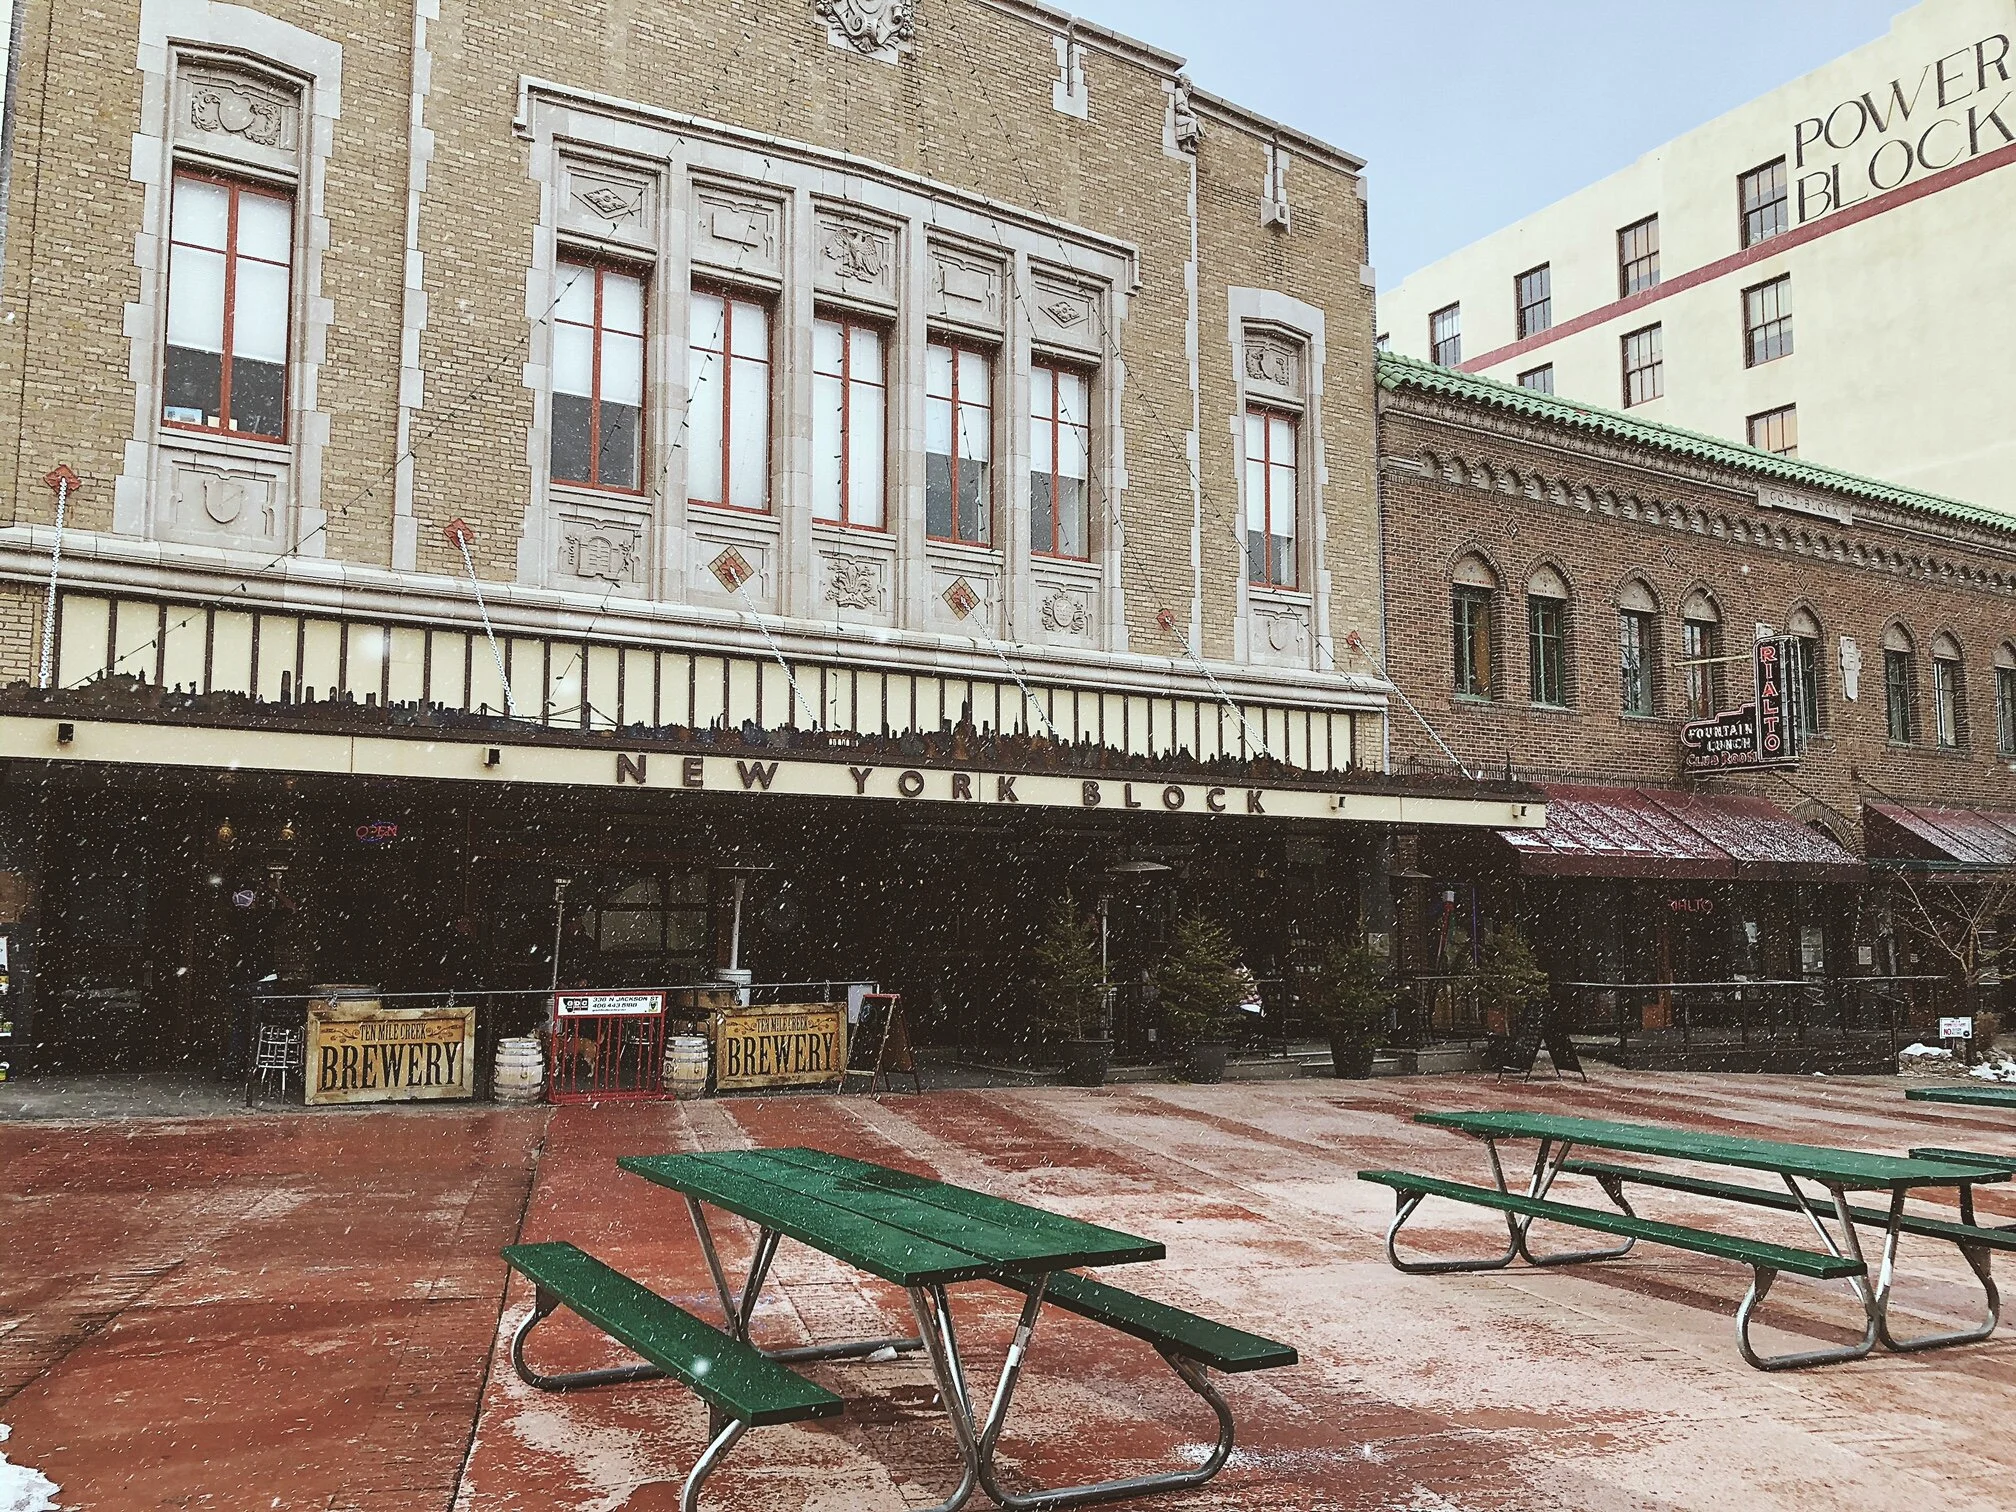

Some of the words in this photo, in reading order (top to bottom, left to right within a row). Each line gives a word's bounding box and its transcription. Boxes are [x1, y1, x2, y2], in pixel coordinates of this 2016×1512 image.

[1794, 33, 2012, 170] POWER
[1797, 90, 2016, 224] BLOCK
[1760, 646, 1780, 751] RIALTO
[1688, 723, 1753, 739] FOUNTAIN
[1707, 737, 1751, 752] LUNCH
[617, 753, 779, 790] NEW
[850, 765, 1019, 803] YORK
[1082, 779, 1266, 815] BLOCK
[359, 1022, 376, 1041] TEN
[378, 1022, 399, 1041] MILE
[401, 1021, 427, 1040] CREEK
[726, 1032, 835, 1077] BREWERY
[1944, 1028, 1952, 1036] NO
[320, 1042, 462, 1092] BREWERY
